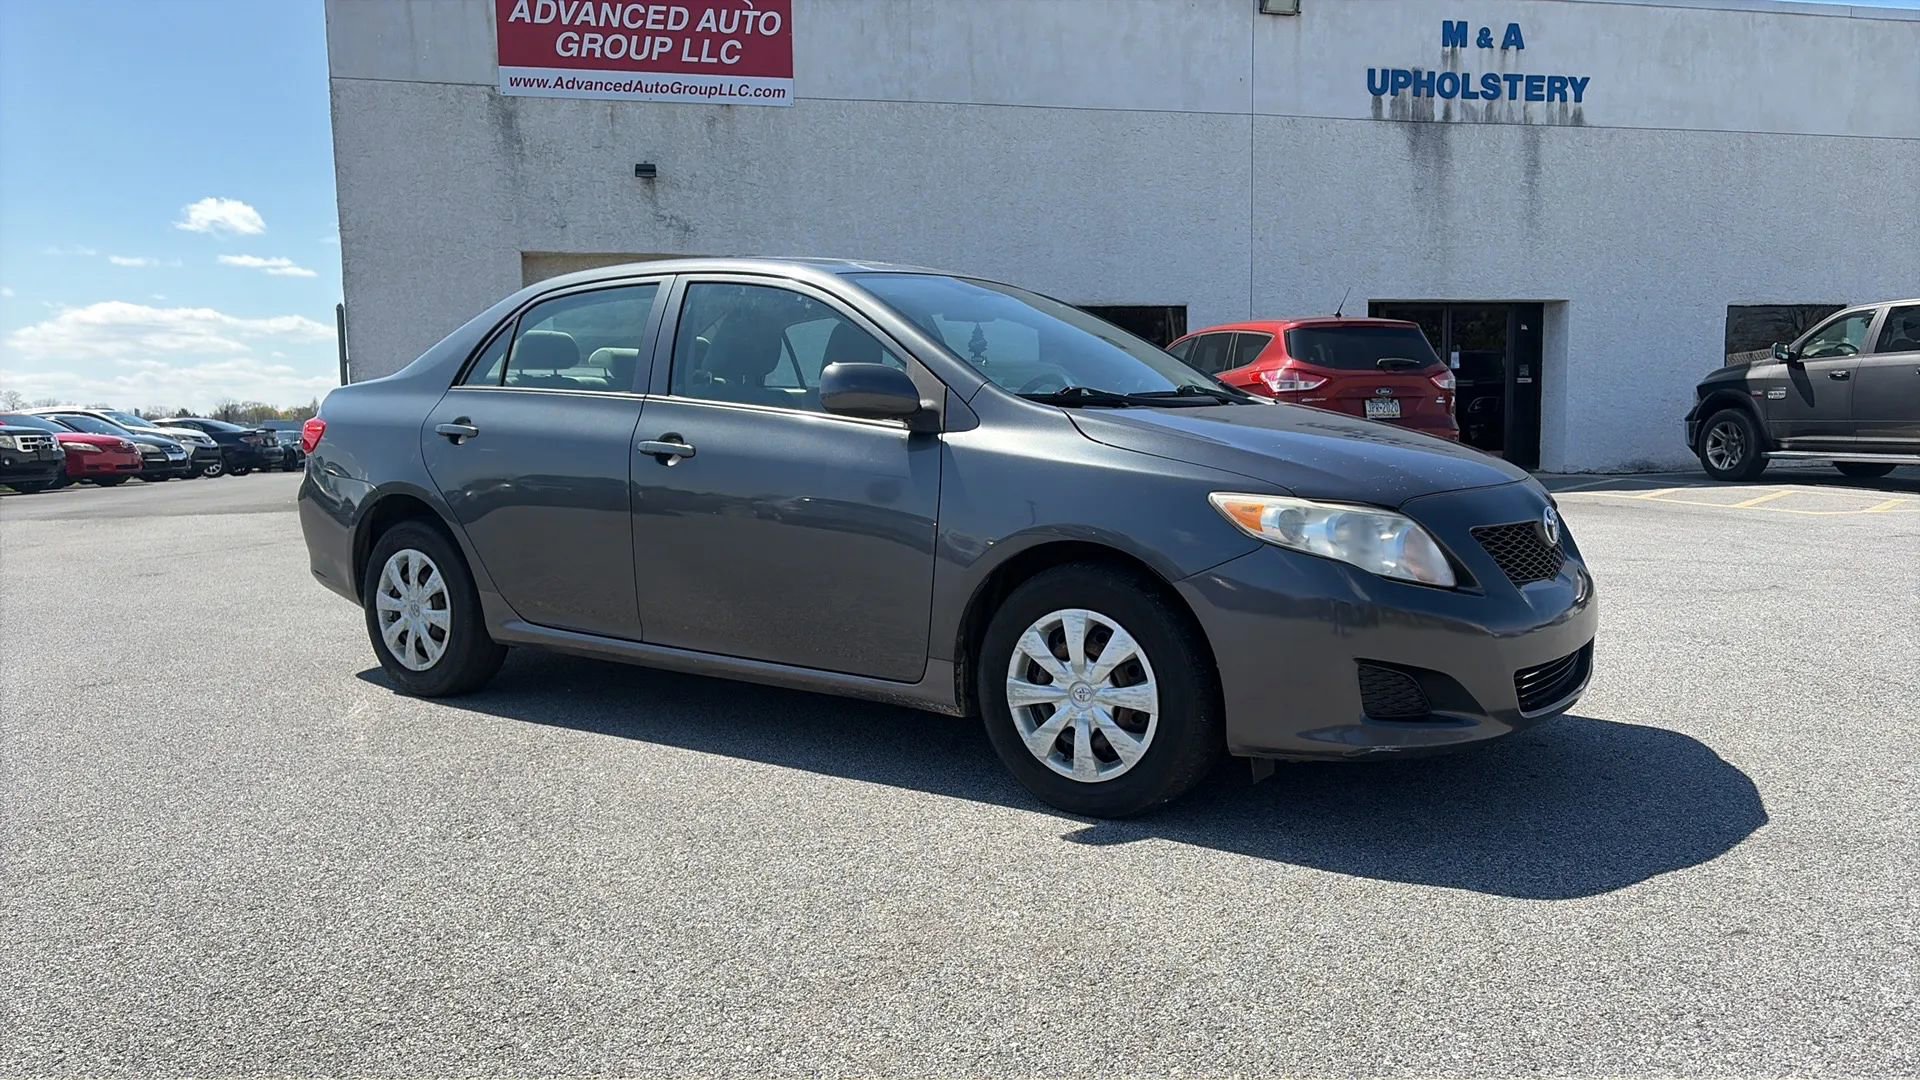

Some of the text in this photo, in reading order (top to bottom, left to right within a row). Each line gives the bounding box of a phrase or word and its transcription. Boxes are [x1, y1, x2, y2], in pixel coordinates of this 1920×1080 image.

[508, 0, 782, 36] ADVANCED AUTO
[1442, 20, 1525, 50] M & A
[555, 31, 743, 65] GROUP LLC
[509, 76, 786, 99] www.AdvancedAutoGroupLLC.com
[1367, 68, 1590, 103] UPHOLSTERY
